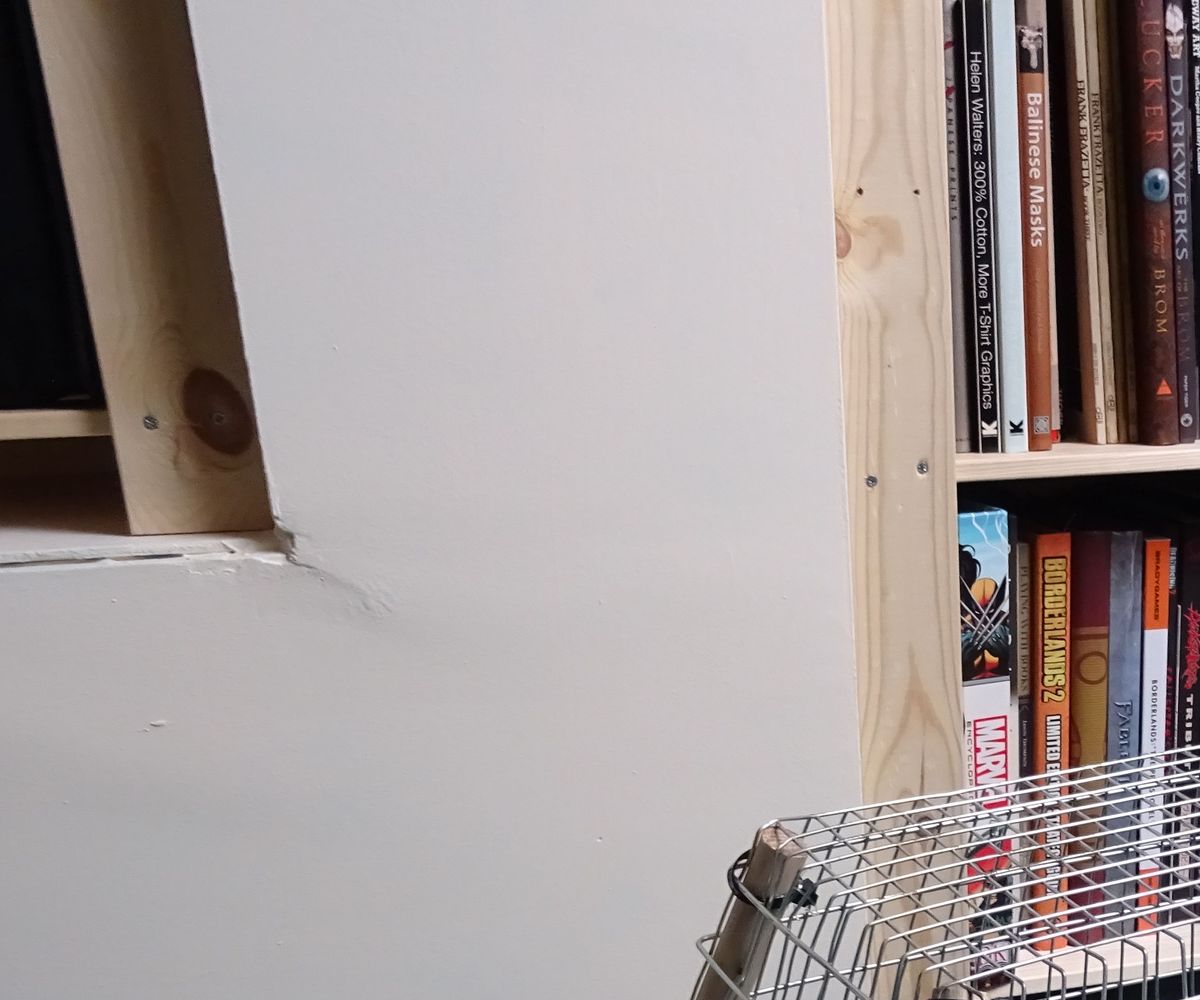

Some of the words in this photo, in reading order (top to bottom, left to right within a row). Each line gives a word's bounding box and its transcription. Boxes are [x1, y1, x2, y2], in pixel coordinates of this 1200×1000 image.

[1192, 34, 1200, 58] ART
[969, 51, 982, 93] Helen
[1139, 0, 1165, 145] UCKER
[1076, 80, 1088, 122] FRANK
[970, 98, 984, 156] Walters:
[1026, 92, 1045, 180] Balinese
[973, 161, 987, 203] 300%
[1169, 75, 1189, 261] DARKWERKS
[975, 207, 989, 259] Cotton,
[1029, 186, 1047, 248] Masks
[977, 263, 990, 299] More
[1153, 268, 1169, 334] BROM
[978, 302, 992, 346] T-Shirt
[979, 350, 995, 411] Graphics
[1019, 566, 1029, 613] PLAYING
[1152, 550, 1161, 622] BRADYGAMES
[1019, 618, 1029, 655] WITH
[1042, 555, 1068, 687] BORDERLANDS
[1018, 657, 1028, 692] BOOKS
[1041, 688, 1067, 704] 2
[1045, 714, 1062, 761] LIMITED
